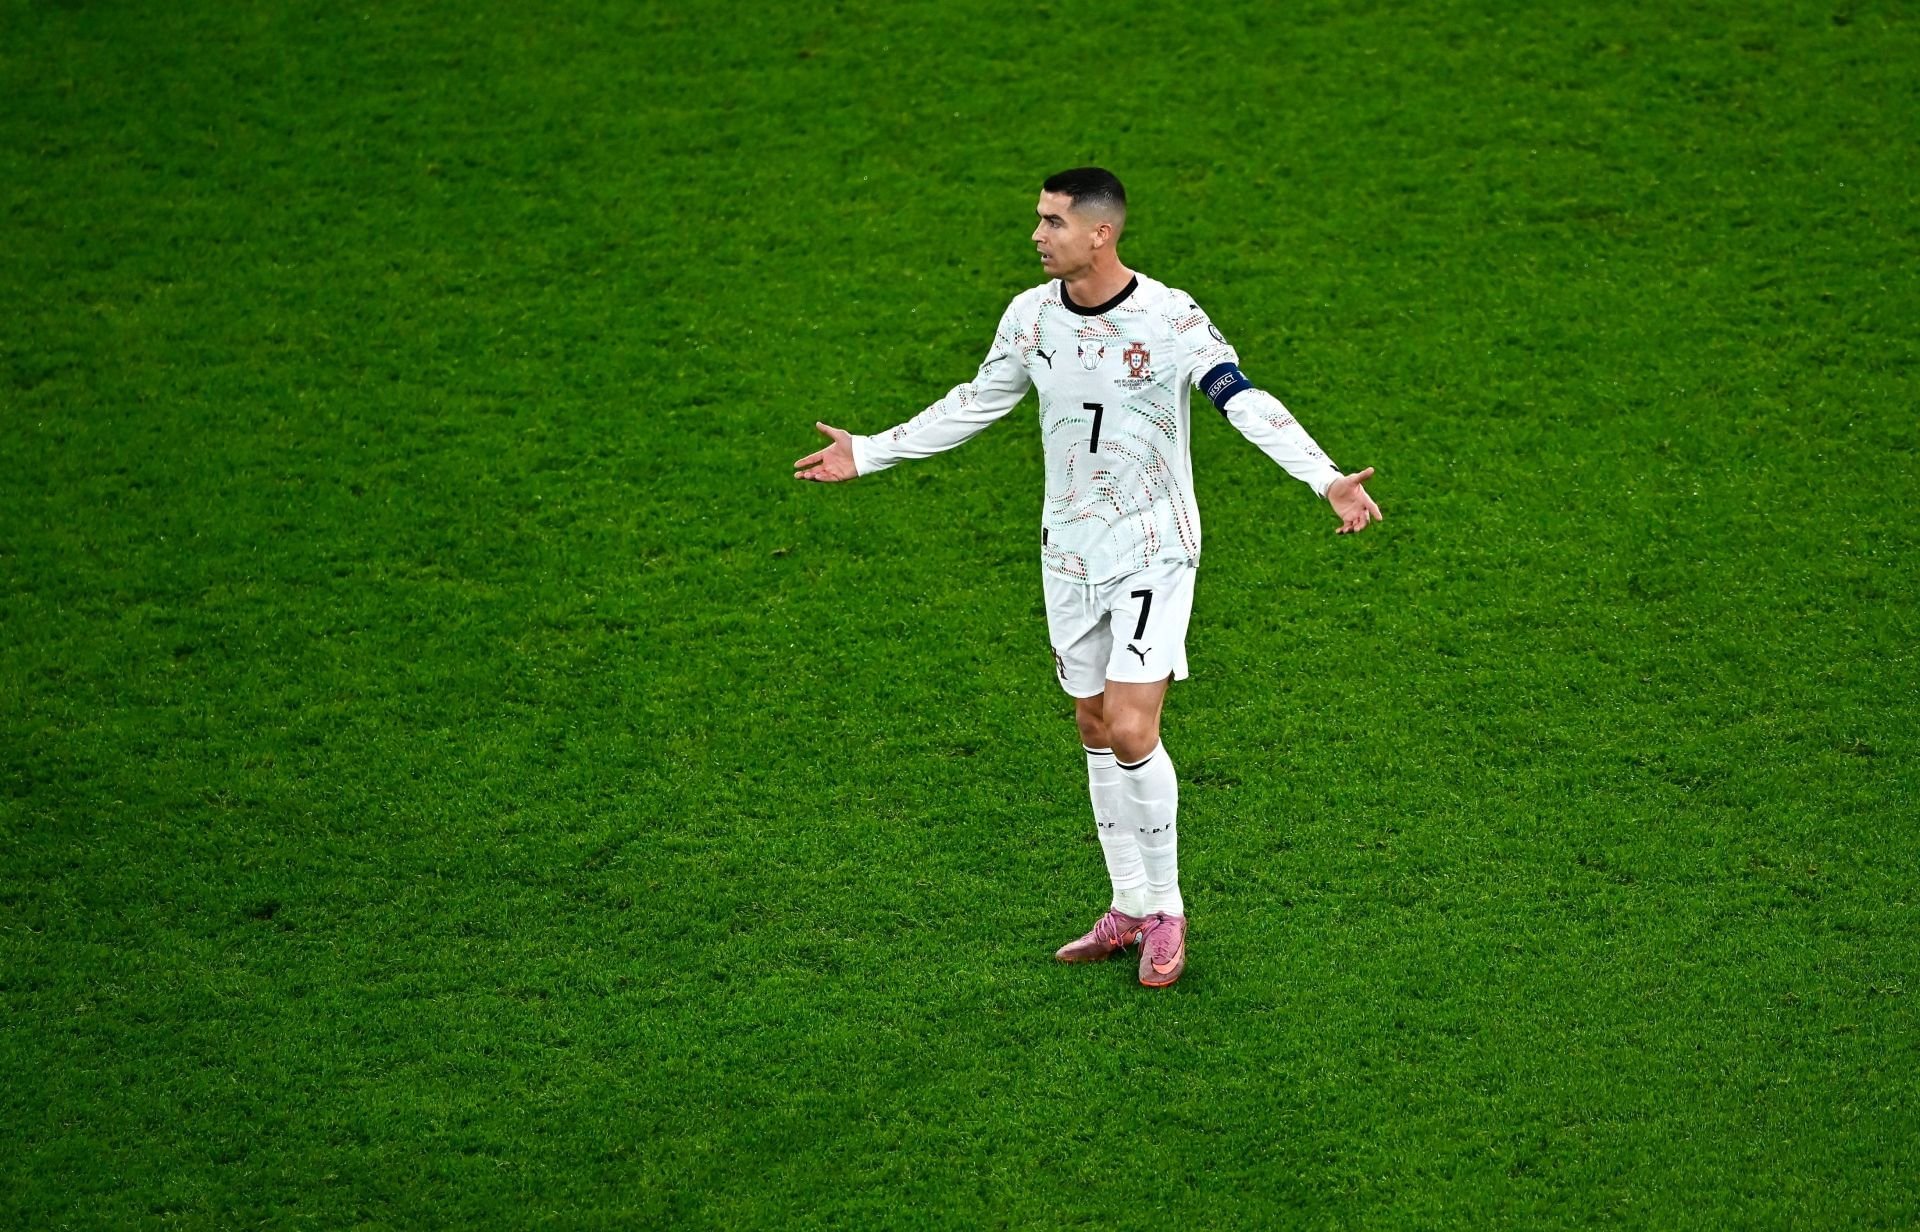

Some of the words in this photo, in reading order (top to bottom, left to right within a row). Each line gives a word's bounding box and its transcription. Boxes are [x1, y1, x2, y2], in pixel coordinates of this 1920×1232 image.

[1209, 373, 1235, 399] RESPECT
[1082, 402, 1104, 454] 7
[1130, 588, 1154, 640] 7
